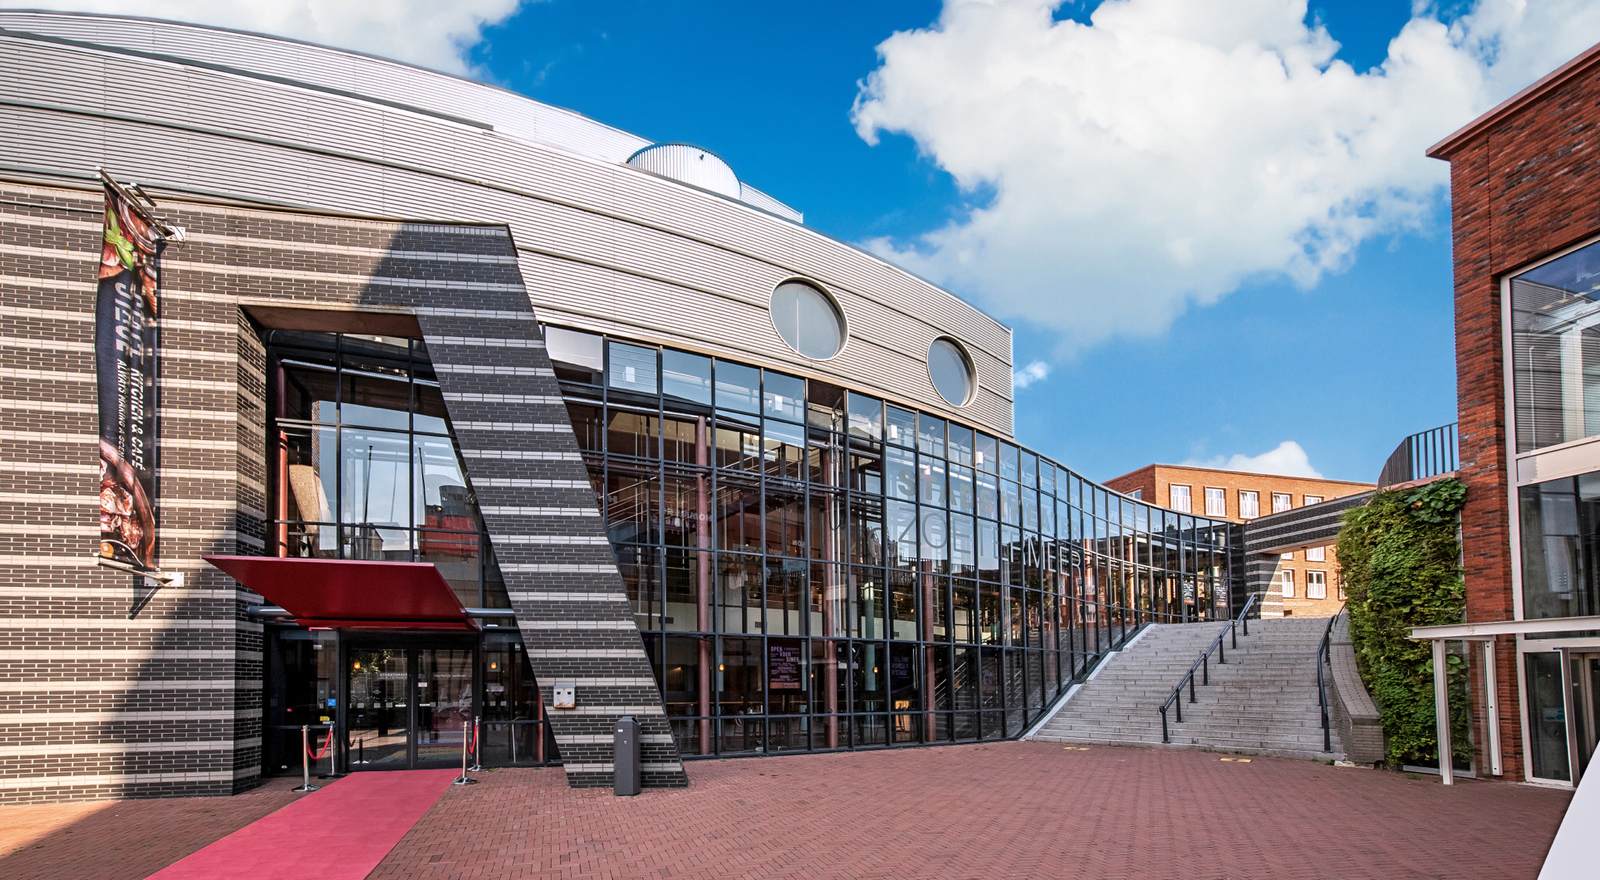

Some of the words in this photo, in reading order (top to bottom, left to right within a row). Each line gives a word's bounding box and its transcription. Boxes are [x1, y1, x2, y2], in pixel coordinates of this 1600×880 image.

[114, 282, 144, 365] STAGE
[117, 358, 127, 394] ALWAYS
[118, 393, 126, 428] MAKING
[131, 368, 144, 425] KITCHEN
[118, 426, 125, 434] A
[131, 424, 144, 435] &
[131, 436, 146, 472] CAFÉ
[898, 468, 1079, 545] STADSTHEAER
